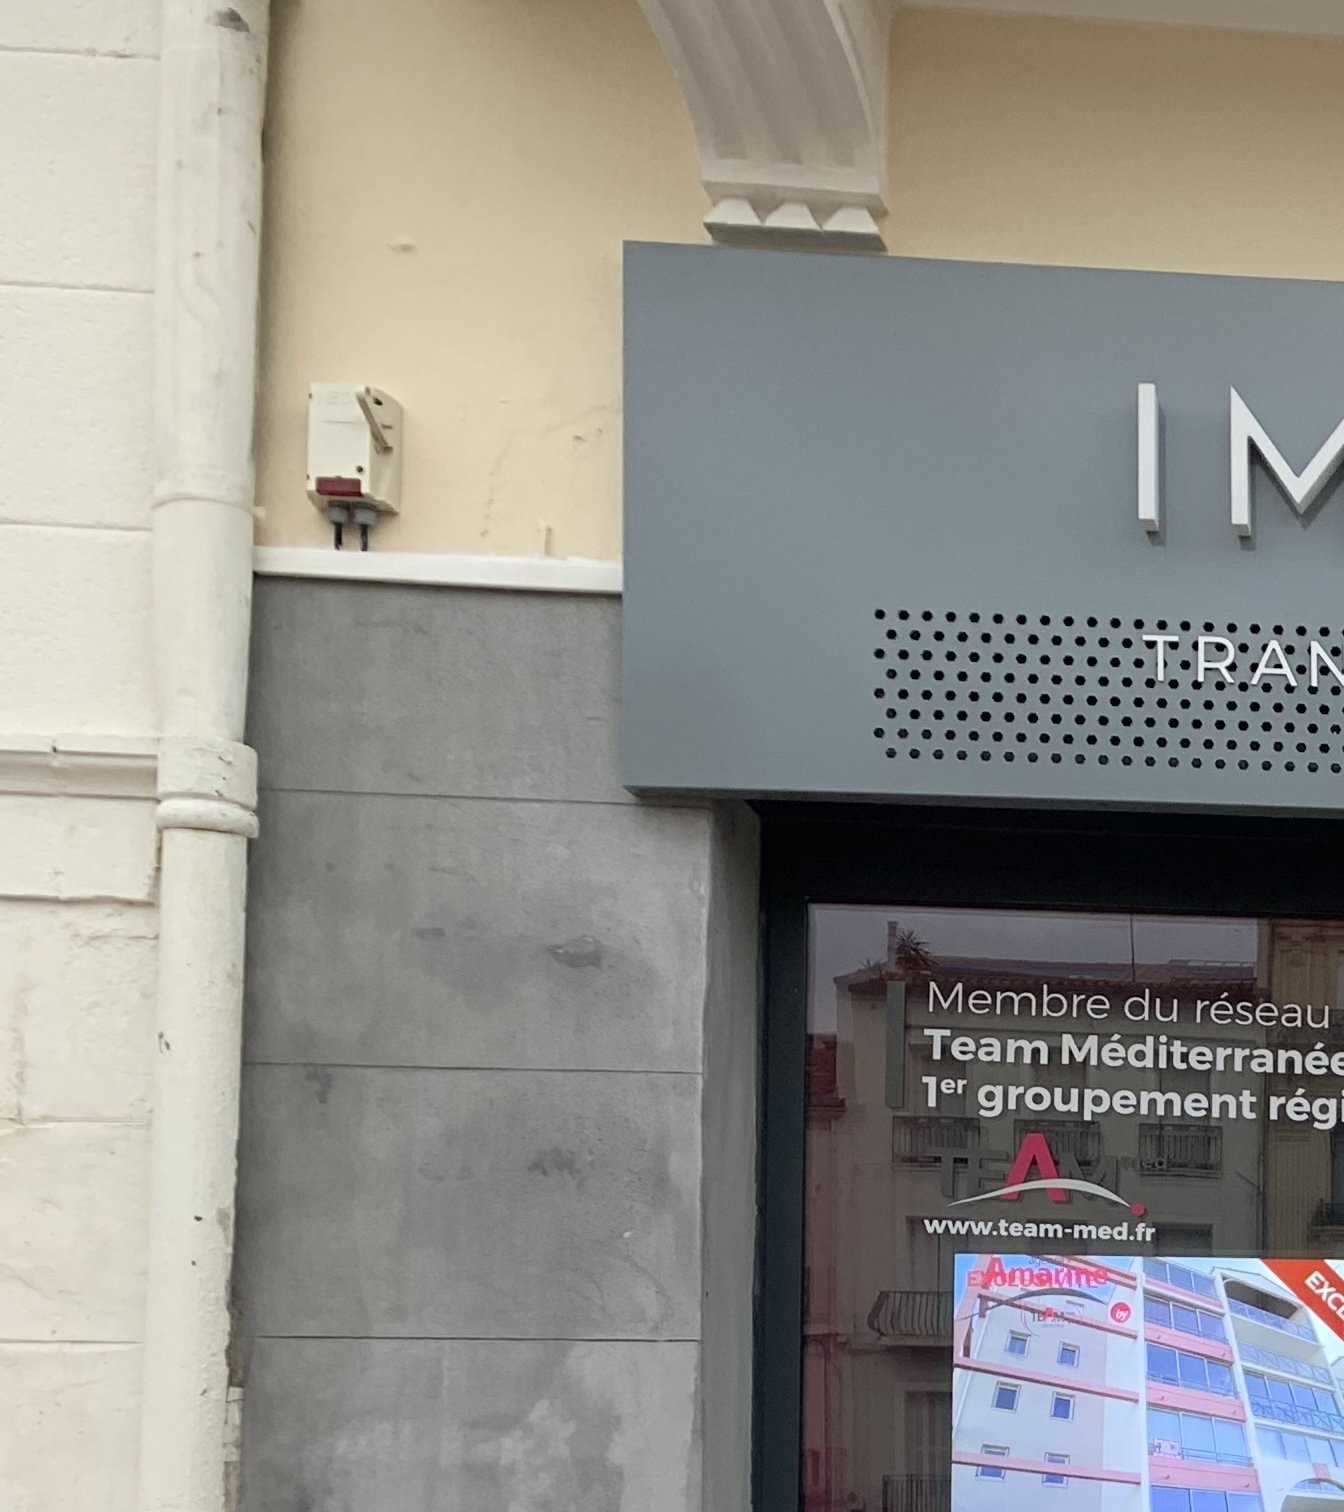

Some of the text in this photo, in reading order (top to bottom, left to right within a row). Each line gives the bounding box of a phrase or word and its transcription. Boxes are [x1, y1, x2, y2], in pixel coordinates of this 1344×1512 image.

[926, 979, 1331, 1030] Membre du réseau
[923, 1027, 1050, 1065] Team
[922, 1074, 968, 1108] 1er
[977, 1081, 1257, 1122] groupement
[923, 1217, 1156, 1242] www.team-med.fr
